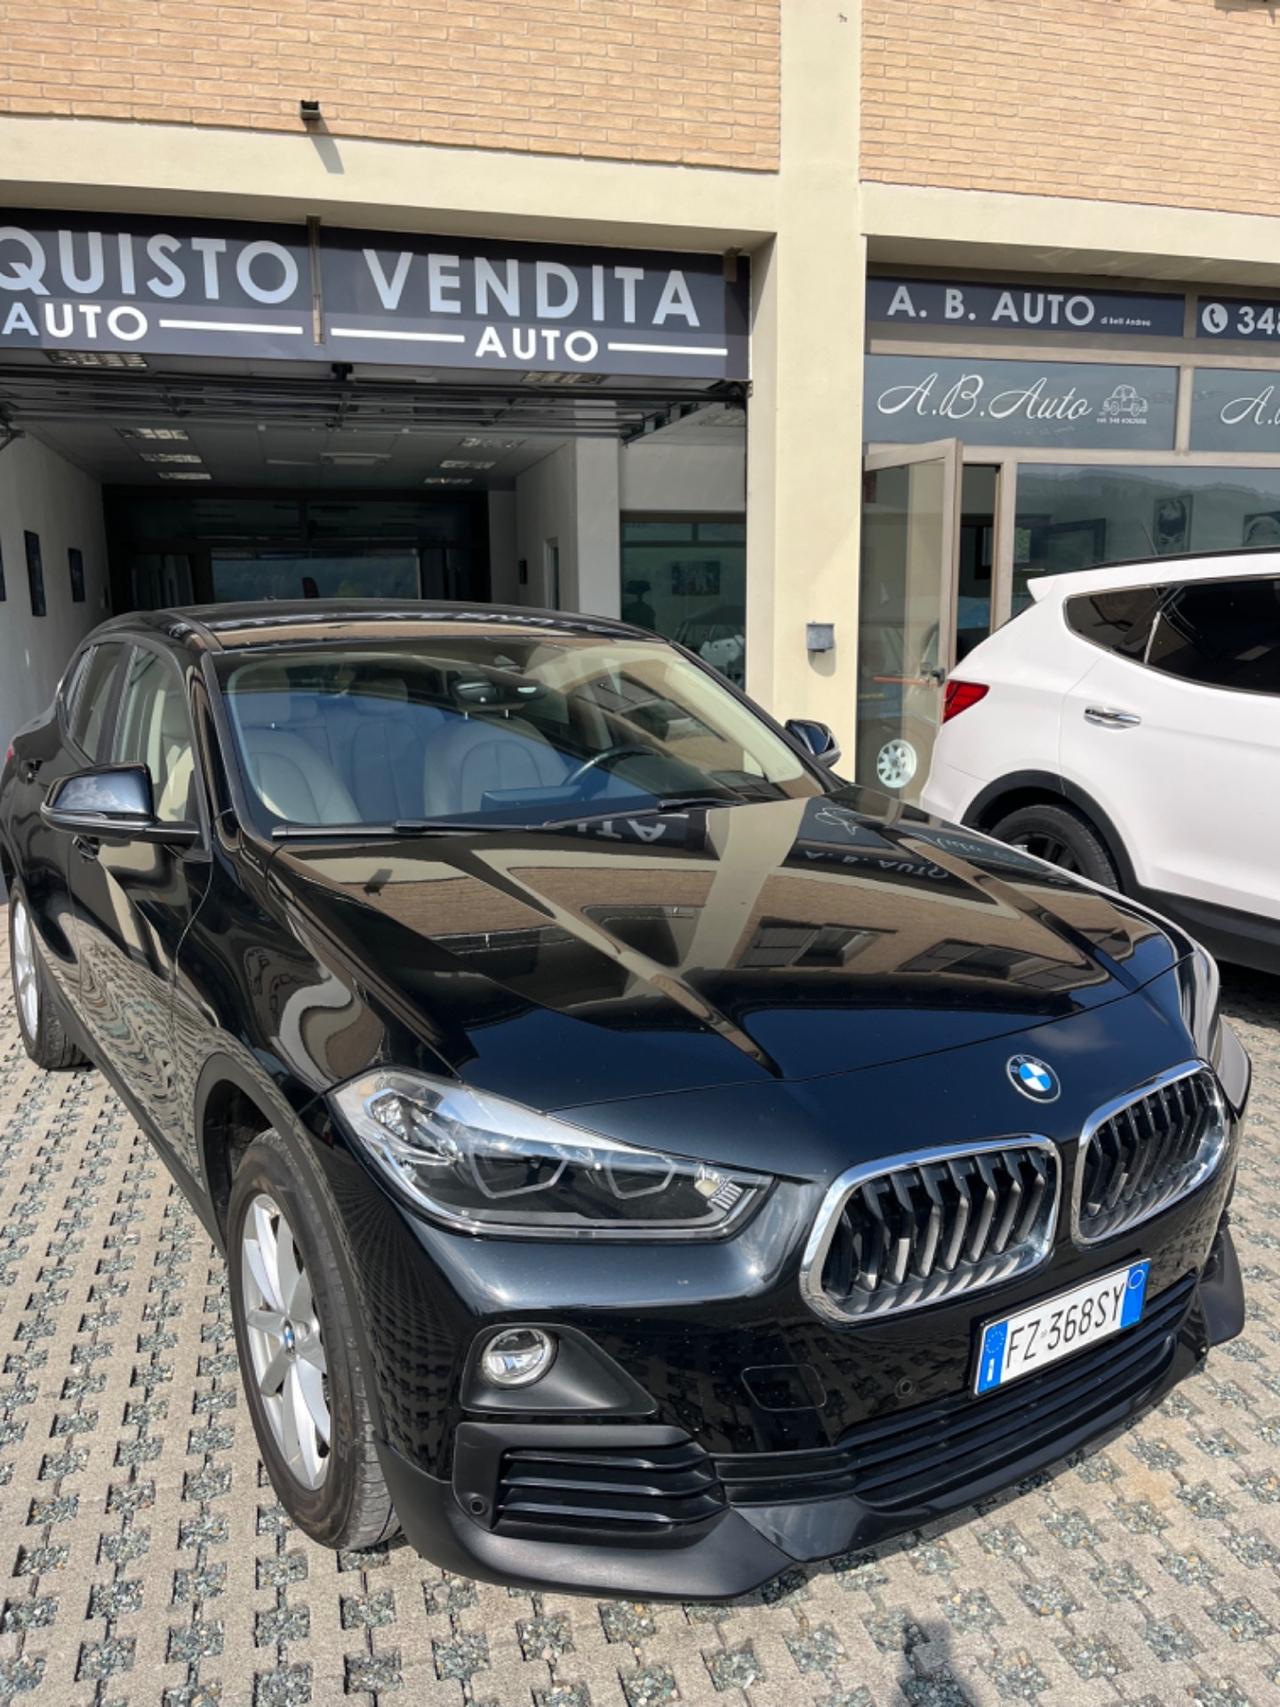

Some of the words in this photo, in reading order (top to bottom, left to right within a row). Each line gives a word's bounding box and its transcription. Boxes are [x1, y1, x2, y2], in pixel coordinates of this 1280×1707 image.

[362, 248, 701, 327] VENDITA
[887, 285, 928, 319] A.
[945, 288, 976, 321] B.
[991, 291, 1096, 326] AUTO
[2, 301, 149, 342] AUTO
[1236, 305, 1280, 335] 34
[474, 326, 599, 363] AUTO
